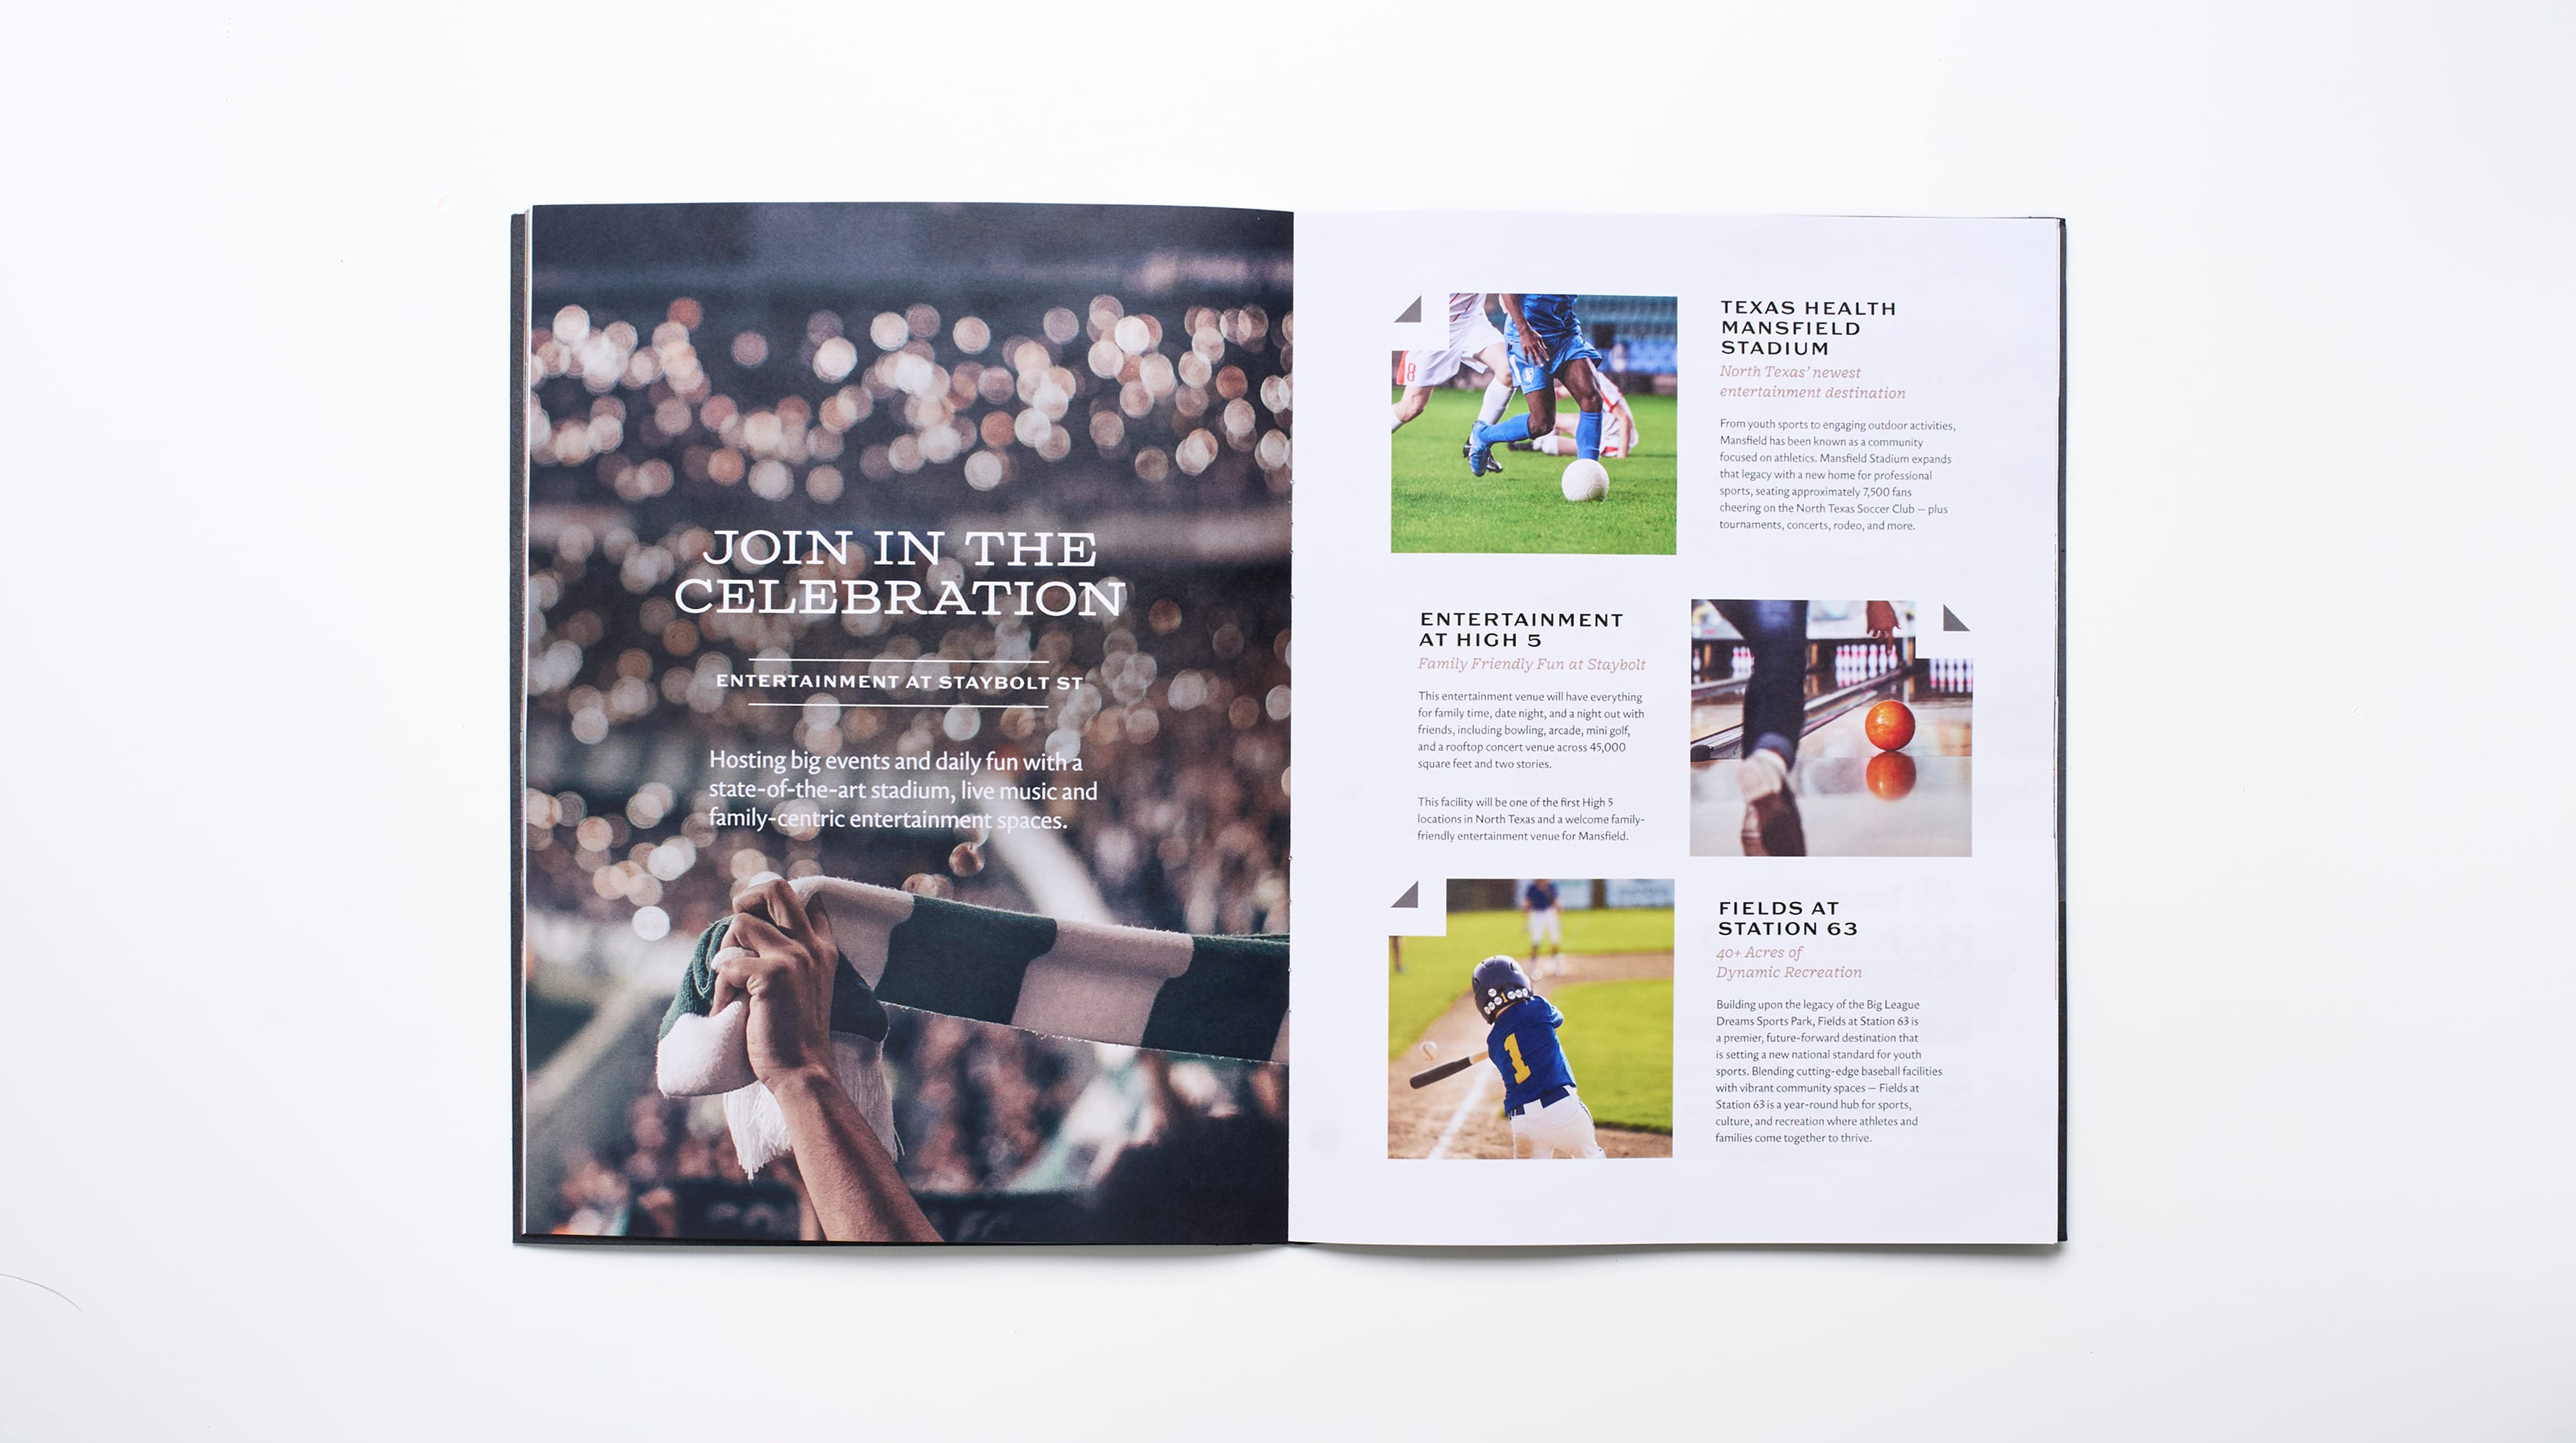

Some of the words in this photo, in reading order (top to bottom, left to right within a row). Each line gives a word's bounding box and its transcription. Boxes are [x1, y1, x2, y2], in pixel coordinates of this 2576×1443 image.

[1720, 300, 1795, 316] TEXAS
[1805, 301, 1896, 316] HEALTH
[1722, 320, 1861, 336] MANSFIELD
[1721, 340, 1828, 356] STADIUM
[1407, 363, 1417, 381] 8
[1719, 365, 1762, 378] North
[1812, 367, 1862, 379] newest
[1719, 385, 1822, 398] entertainment
[1824, 386, 1906, 400] destination
[1720, 418, 1746, 429] From
[1747, 418, 1776, 431] youth
[1777, 420, 1809, 432] sports
[1810, 421, 1822, 430] to
[1822, 420, 1867, 433] engaging
[1867, 419, 1908, 431] outdoor
[1909, 420, 1956, 433] activities,
[1719, 451, 1758, 462] focused
[1773, 451, 1818, 463] athletics.
[1819, 453, 1868, 464] Mansfield
[1869, 453, 1910, 464] Stadium
[1911, 453, 1952, 467] expands
[1719, 486, 1754, 498] sports,
[1755, 486, 1791, 500] seating
[1791, 486, 1862, 500] approximately
[1862, 486, 1891, 500] 7,500
[1891, 486, 1912, 498] fans
[1719, 520, 1785, 532] tournaments,
[1786, 521, 1832, 532] concerts,
[1833, 519, 1865, 533] rodeo,
[1867, 519, 1885, 531] and
[1886, 523, 1916, 531] more.
[702, 529, 853, 565] JOIN
[873, 531, 945, 566] IN
[964, 531, 1096, 567] THE
[674, 578, 1126, 617] CELEBRATION
[1421, 612, 1624, 628] ENTERTAINMENT
[1418, 632, 1449, 648] AT
[1456, 632, 1517, 648] HIGH
[1527, 634, 1542, 648] 5
[1417, 656, 1469, 673] Family
[1470, 657, 1534, 674] Friendly
[1536, 657, 1565, 670] Fun
[1568, 659, 1585, 671] at
[1587, 658, 1647, 675] Staybolt
[716, 674, 900, 688] ENTERTAINMENT
[905, 676, 932, 689] AT
[939, 676, 1050, 690] STAYBOLT
[1056, 677, 1083, 690] ST
[1417, 690, 1440, 702] This
[1441, 691, 1514, 702] entertainment
[1514, 693, 1545, 702] venue
[1546, 690, 1564, 702] will
[1565, 690, 1589, 702] have
[1590, 691, 1643, 705] everything
[1417, 723, 1456, 737] friends,
[1457, 723, 1503, 738] including
[1504, 723, 1547, 738] bowling,
[1548, 724, 1585, 738] arcade,
[1586, 725, 1608, 735] mini
[1608, 724, 1631, 739] golf,
[1417, 741, 1437, 752] and
[1437, 743, 1444, 752] a
[1445, 740, 1484, 755] rooftop
[1485, 743, 1524, 753] concert
[1524, 744, 1556, 753] venue
[1556, 744, 1589, 753] across
[1589, 741, 1627, 755] 45,000
[709, 749, 787, 775] Hosting
[791, 749, 821, 775] big
[825, 753, 890, 770] events
[894, 751, 931, 771] and
[935, 751, 982, 776] daily
[985, 751, 1019, 771] fun
[1022, 751, 1068, 772] with
[1071, 757, 1083, 772] a
[1417, 760, 1451, 771] square
[1452, 757, 1473, 769] feet
[1474, 757, 1493, 769] and
[1494, 759, 1515, 769] two
[1516, 758, 1552, 769] stories.
[709, 778, 867, 799] state-of-the-art
[871, 779, 956, 804] stadium,
[961, 780, 995, 799] live
[999, 781, 1057, 800] music
[1061, 781, 1098, 801] and
[709, 806, 845, 832] family-centric
[849, 810, 993, 829] entertainment
[997, 815, 1068, 834] spaces.
[1417, 813, 1462, 825] locations
[1464, 814, 1474, 824] in
[1475, 813, 1506, 825] North
[1507, 813, 1536, 825] Texas
[1536, 813, 1556, 825] and
[1557, 816, 1564, 825] a
[1564, 813, 1610, 825] welcome
[1610, 813, 1645, 827] family-
[1417, 829, 1456, 844] friendly
[1456, 831, 1529, 841] entertainment
[1561, 830, 1577, 841] for
[1578, 830, 1629, 841] Mansfield.
[1719, 901, 1803, 916] FIELDS
[1810, 901, 1840, 916] AT
[1718, 921, 1817, 936] STATION
[1826, 922, 1858, 936] 63
[1715, 948, 1742, 961] 40+
[1744, 945, 1785, 959] Acres
[1788, 945, 1805, 962] of
[1715, 965, 1781, 982] Dynamic
[1783, 965, 1862, 979] Recreation
[1717, 998, 1757, 1012] Building
[1758, 1002, 1783, 1012] upon
[1785, 998, 1801, 1010] the
[1803, 998, 1834, 1012] legacy
[1836, 998, 1847, 1010] of
[1848, 998, 1865, 1010] the
[1867, 999, 1883, 1012] Big
[1884, 999, 1920, 1012] League
[1716, 1016, 1755, 1026] Dreams
[1756, 1016, 1789, 1029] Sports
[1791, 1015, 1816, 1028] Park,
[1817, 1015, 1847, 1026] Fields
[1847, 1018, 1859, 1026] at
[1859, 1016, 1896, 1026] Station
[1896, 1016, 1910, 1026] 63
[1911, 1016, 1919, 1026] is
[1723, 1033, 1765, 1045] premier,
[1766, 1031, 1840, 1043] future-forward
[1842, 1032, 1897, 1043] destination
[1898, 1032, 1919, 1043] that
[1504, 1033, 1531, 1084] 1
[1715, 1067, 1750, 1079] sports.
[1752, 1065, 1795, 1079] Blending
[1796, 1065, 1860, 1079] cutting-edge
[1861, 1065, 1900, 1076] baseball
[1902, 1065, 1943, 1076] facilities
[1715, 1115, 1753, 1128] culture,
[1754, 1115, 1773, 1127] and
[1775, 1116, 1825, 1127] recreation
[1826, 1115, 1858, 1127] where
[1859, 1115, 1898, 1127] athletes
[1900, 1115, 1918, 1127] and
[1715, 1132, 1753, 1143] families
[1754, 1134, 1782, 1143] come
[1783, 1132, 1827, 1146] together
[1828, 1134, 1839, 1143] to
[1840, 1132, 1873, 1143] thrive.
